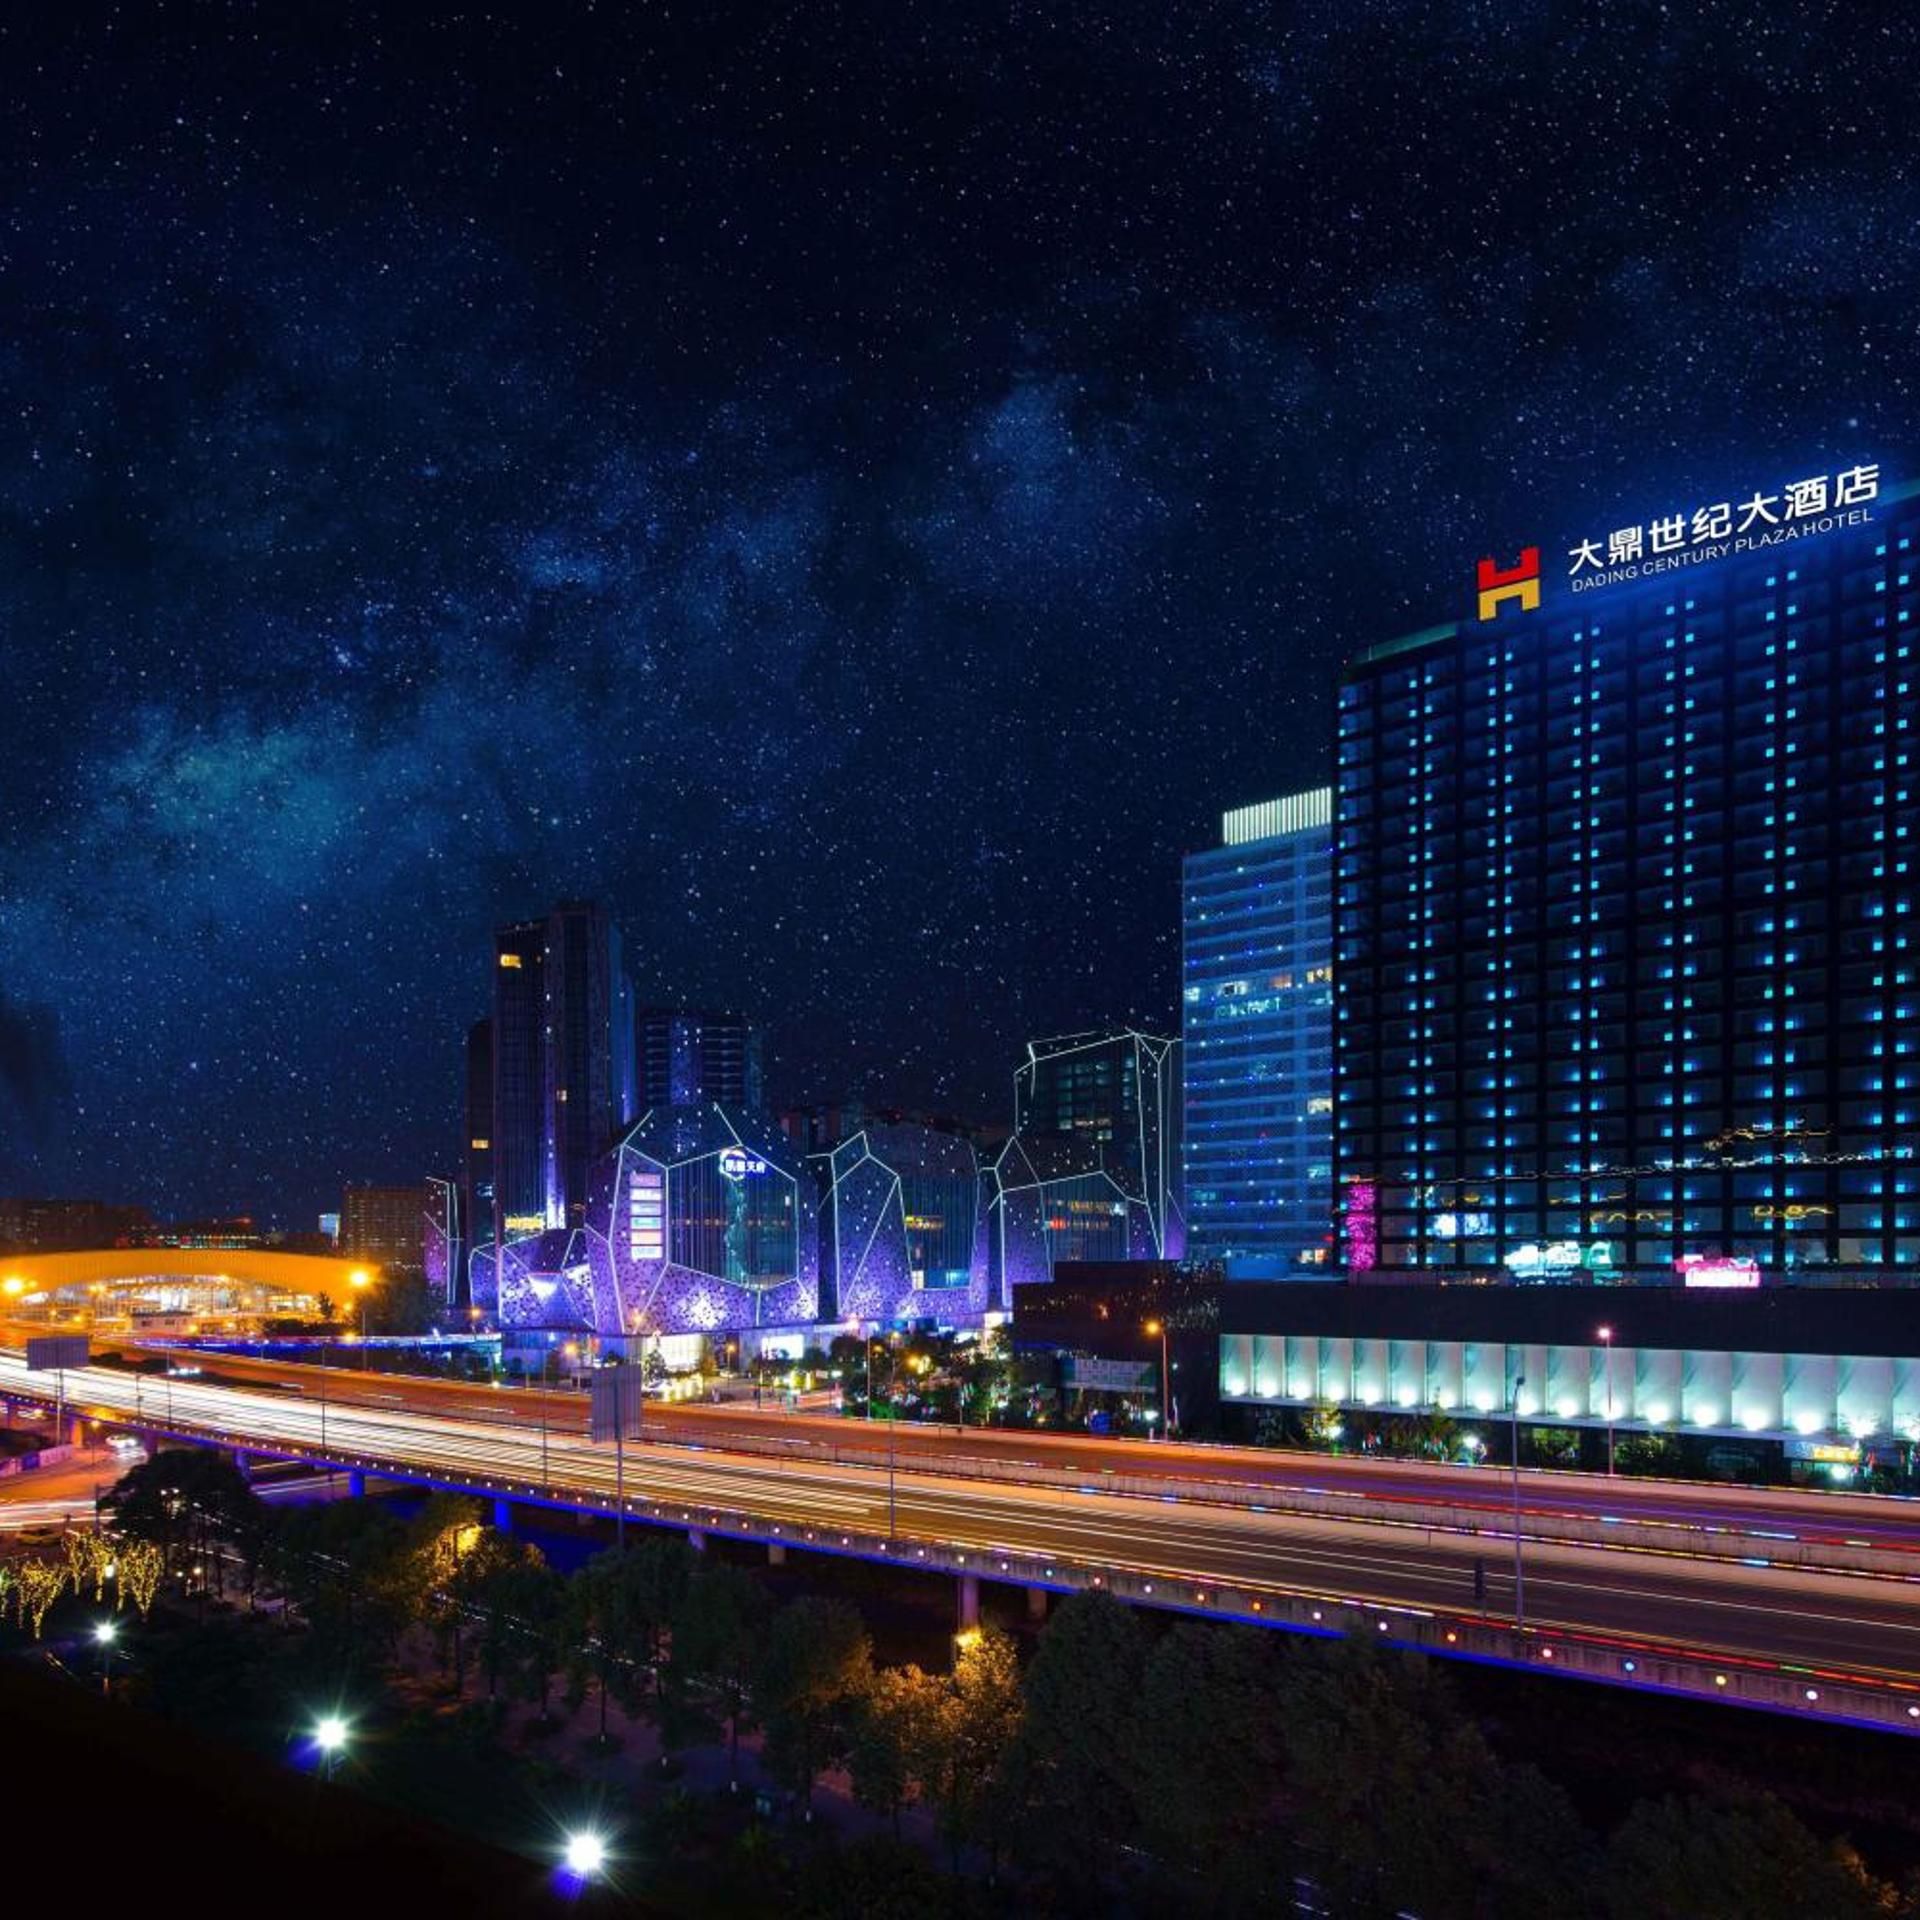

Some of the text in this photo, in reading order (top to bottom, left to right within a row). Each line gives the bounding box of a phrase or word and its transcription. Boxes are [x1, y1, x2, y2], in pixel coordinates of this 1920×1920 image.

[1568, 464, 1880, 576] 大鼎世纪大酒店
[1572, 508, 1875, 592] DADING CENTURY PLAZA HOTEL
